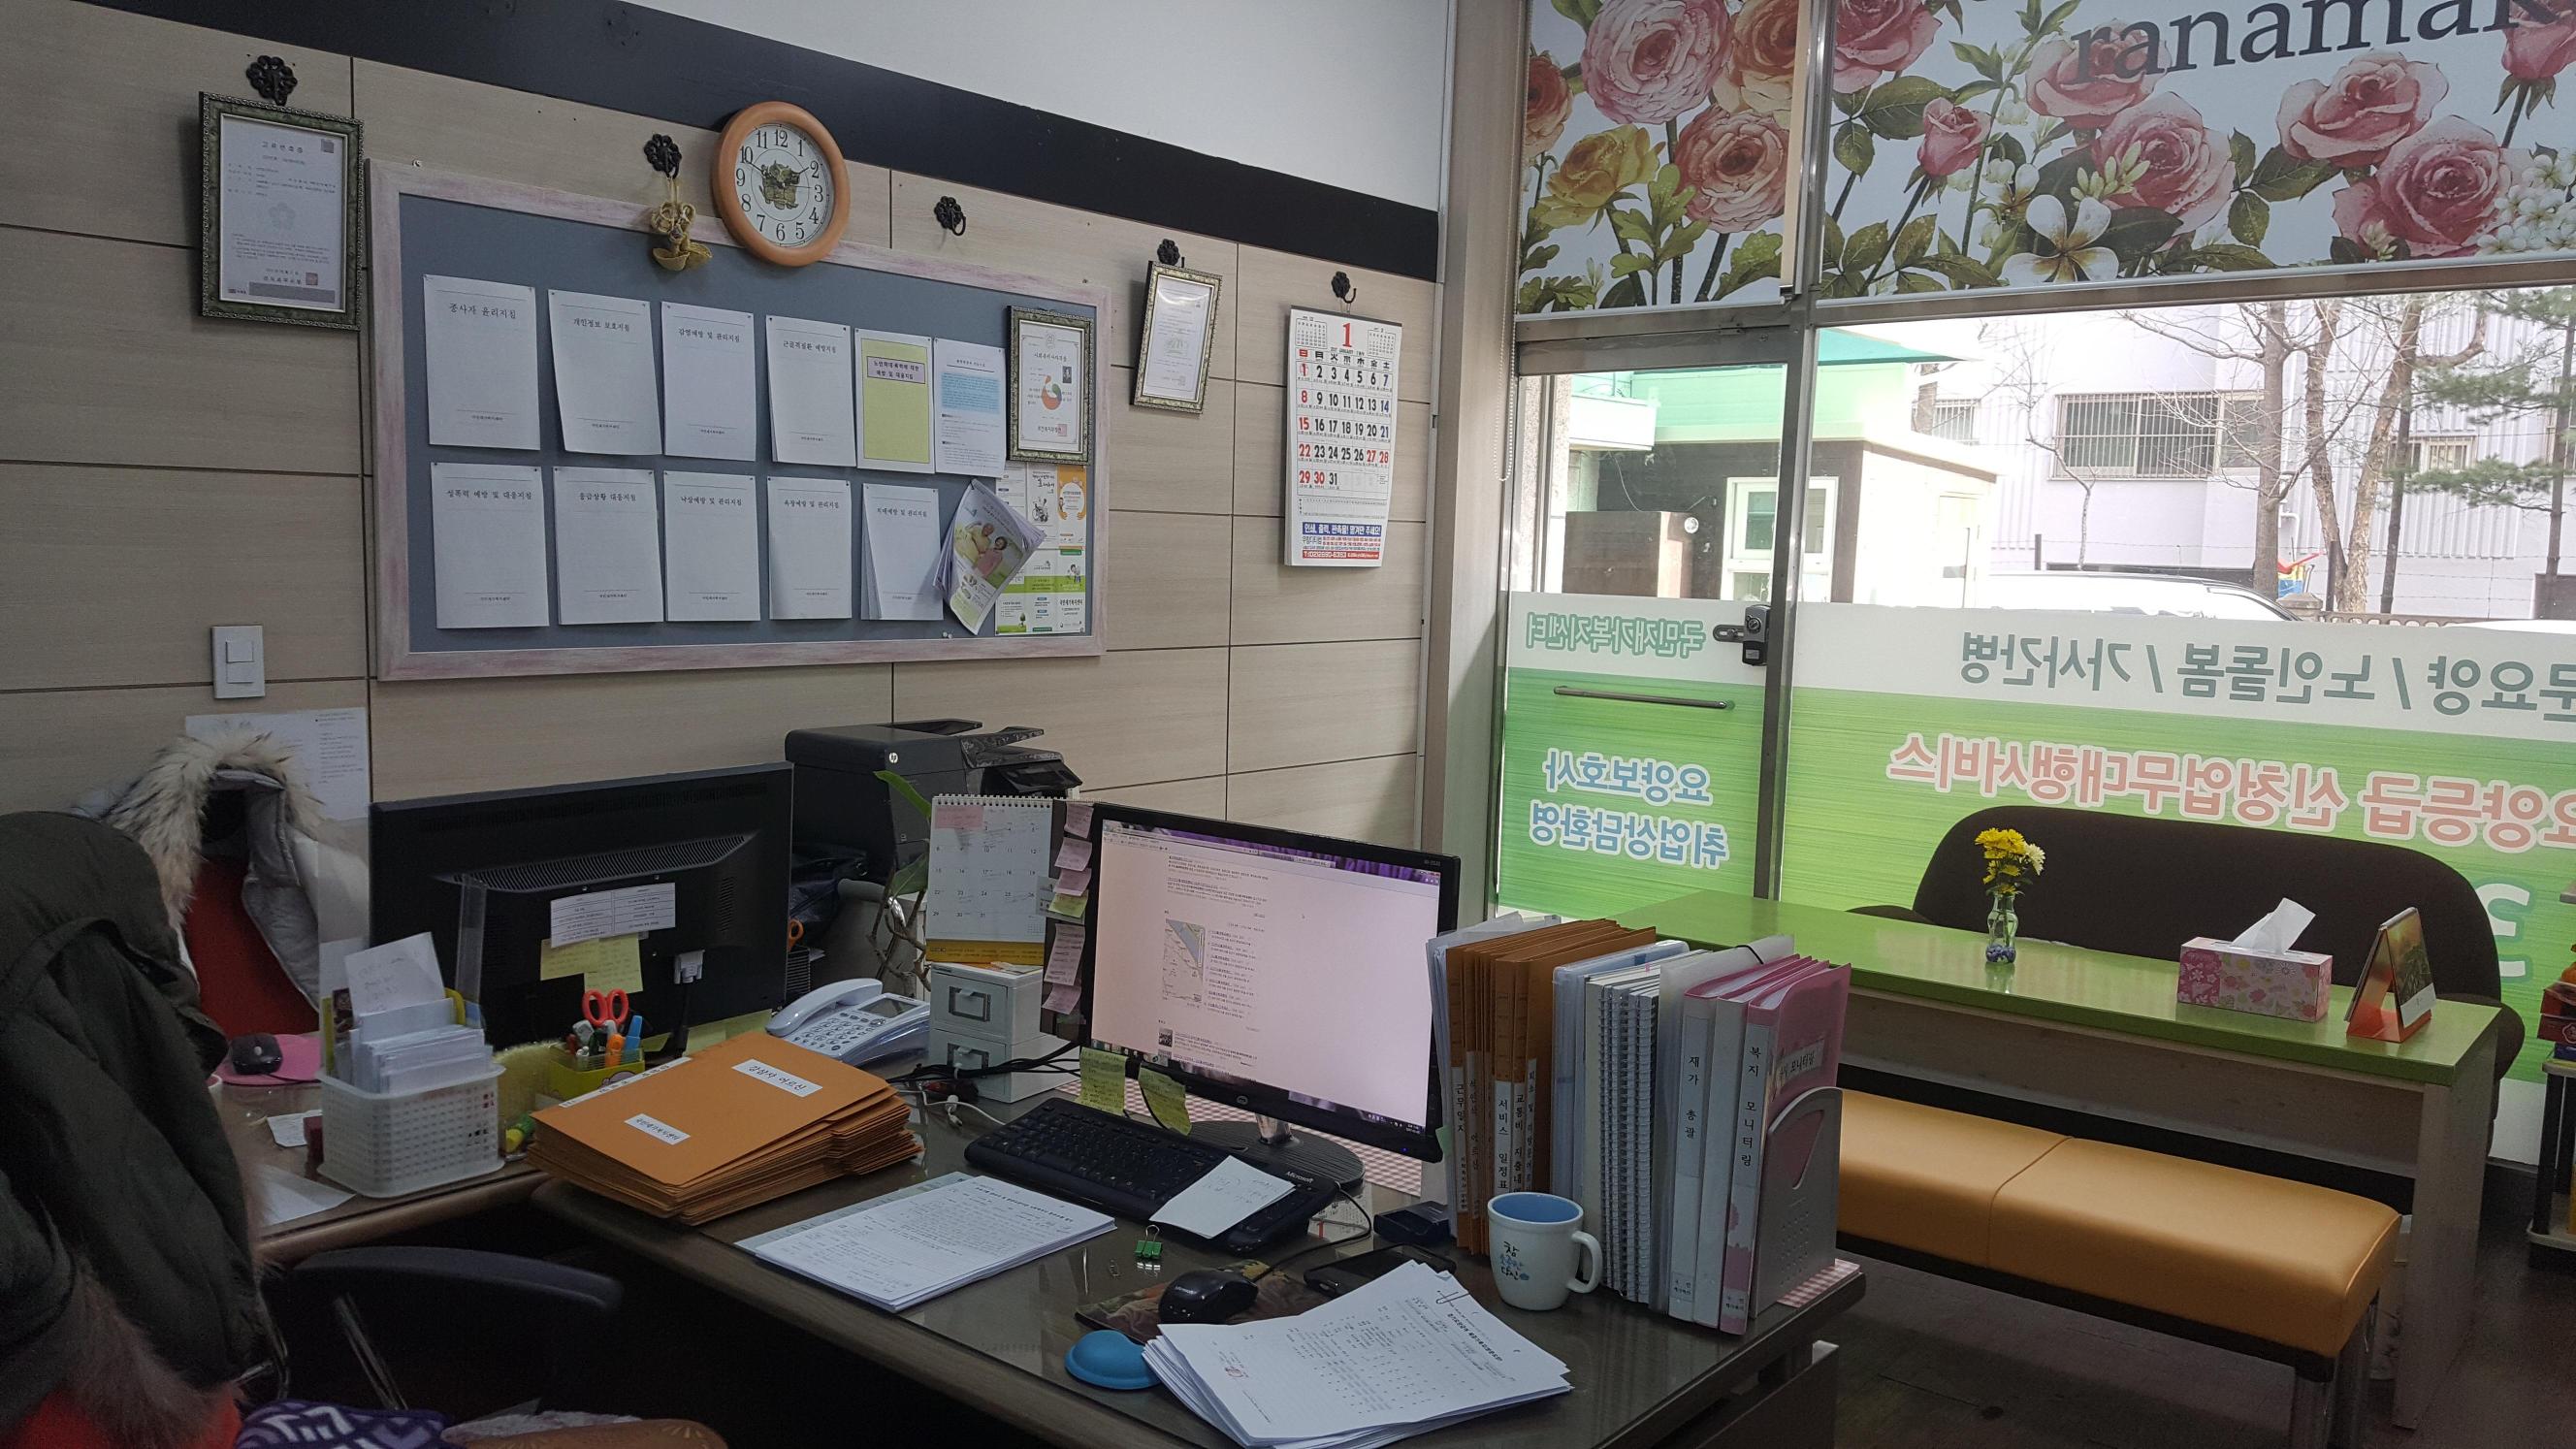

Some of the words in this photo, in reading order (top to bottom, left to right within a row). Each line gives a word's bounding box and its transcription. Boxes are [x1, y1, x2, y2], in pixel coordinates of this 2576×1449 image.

[757, 130, 767, 148] 11
[774, 130, 788, 147] 12
[740, 145, 753, 164] 10
[798, 140, 803, 157] 1
[736, 168, 745, 186] 9
[810, 160, 820, 178] 2
[814, 184, 823, 202] 3
[741, 194, 751, 211] 8
[757, 214, 765, 232] 7
[809, 207, 819, 224] 4
[776, 223, 786, 241] 6
[795, 222, 805, 239] 5
[449, 303, 476, 315] 종사자
[481, 306, 516, 319] 윤리지침
[573, 318, 600, 328] 개인정보
[604, 321, 629, 332] 보호지침
[717, 334, 740, 342] 관리지침
[1342, 322, 1352, 347] 1
[1302, 363, 1306, 376] 1
[1316, 366, 1323, 378] 2
[1331, 367, 1336, 379] 3
[1344, 369, 1349, 382] 4
[1357, 370, 1363, 383] 5
[1370, 372, 1376, 385] 6
[1383, 373, 1389, 387] 7
[1301, 390, 1307, 403] 8
[1316, 392, 1323, 404] 9
[1329, 393, 1338, 406] 10
[1343, 396, 1351, 407] 11
[1355, 397, 1364, 409] 12
[1368, 399, 1376, 411] 13
[1380, 400, 1389, 412] 14
[1299, 417, 1309, 431] 15
[1315, 418, 1325, 432] 16
[1329, 420, 1337, 433] 17
[1342, 422, 1351, 435] 18
[1355, 423, 1364, 435] 19
[1367, 424, 1377, 436] 20
[1380, 426, 1389, 438] 21
[1299, 444, 1310, 457] 22
[1314, 445, 1325, 458] 23
[1329, 446, 1338, 459] 24
[1341, 447, 1351, 460] 25
[1354, 448, 1364, 462] 26
[1367, 450, 1376, 463] 27
[1379, 451, 1389, 464] 28
[1299, 470, 1310, 483] 29
[1314, 471, 1325, 484] 30
[1330, 472, 1337, 485] 31
[473, 490, 488, 499] 예방
[502, 492, 531, 500] 대응지침
[1749, 1046, 1761, 1077] 복지
[1689, 1057, 1699, 1085] 재가
[1498, 1100, 1509, 1135] 서비스
[1515, 1094, 1524, 1131] 교통비
[1685, 1110, 1696, 1139] 총괄
[1742, 1101, 1756, 1167] 모니터링
[1285, 1171, 1314, 1183] Microsoft
[1498, 1153, 1509, 1189] 일정표
